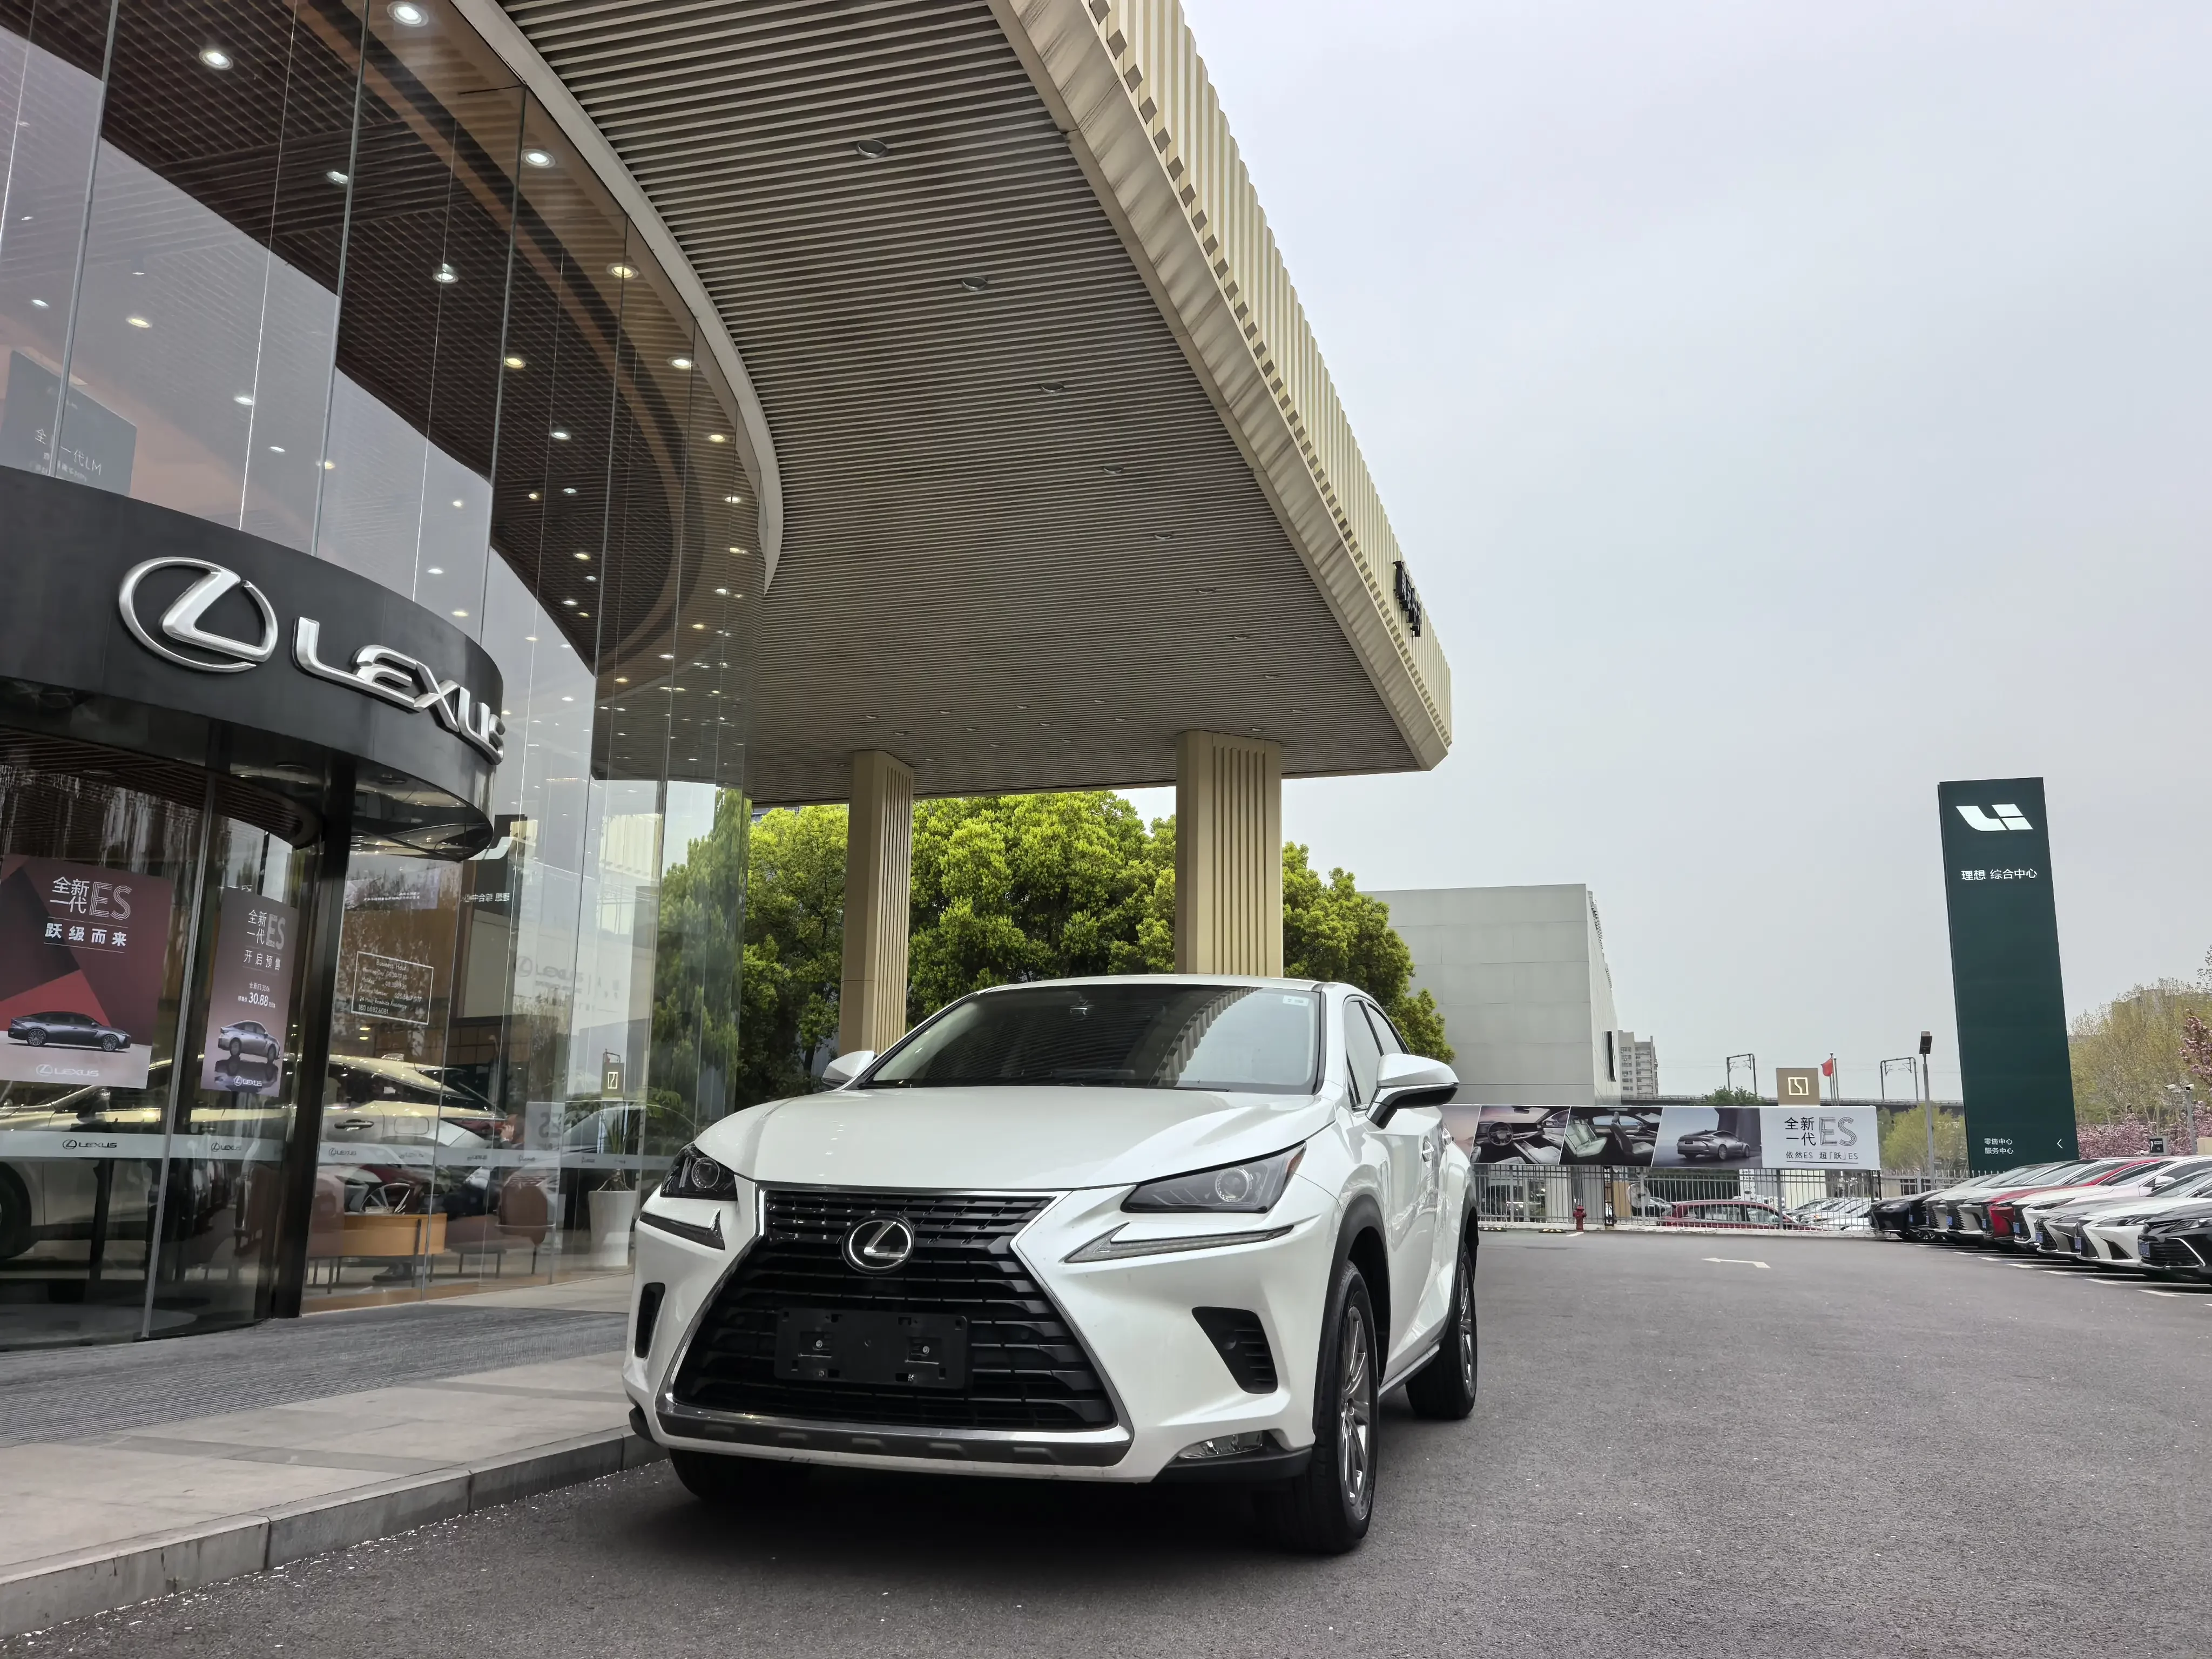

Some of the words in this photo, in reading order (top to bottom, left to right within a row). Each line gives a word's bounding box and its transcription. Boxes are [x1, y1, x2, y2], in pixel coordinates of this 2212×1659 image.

[1961, 869, 1986, 880] 理想
[1990, 868, 2038, 879] 综合中心
[52, 876, 90, 896] 全新
[50, 896, 87, 914] 一代
[89, 881, 132, 920] ES
[248, 909, 267, 927] 全新
[45, 922, 126, 946] 跃级而来
[247, 928, 265, 945] 一代
[266, 913, 286, 949] ES
[248, 992, 269, 1006] 30.88
[55, 1068, 99, 1077] LEXUS
[242, 1078, 262, 1087] LEXUS
[1784, 1117, 1815, 1130] 全新
[1819, 1117, 1857, 1146] ES
[1786, 1132, 1816, 1146] 一代
